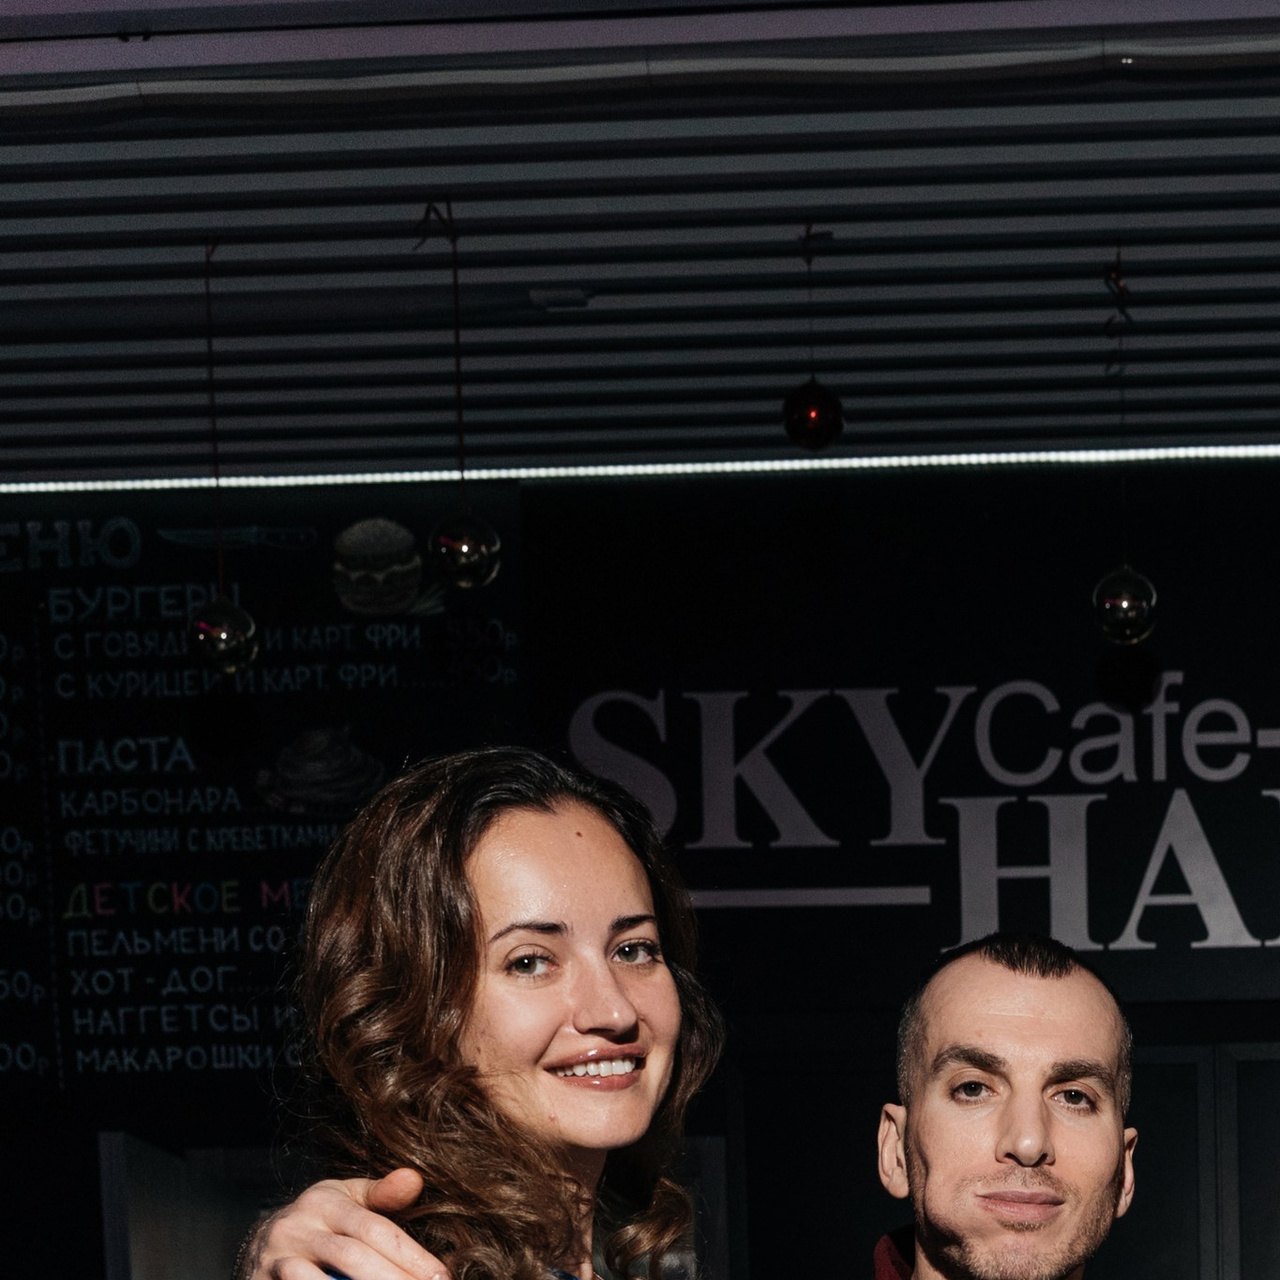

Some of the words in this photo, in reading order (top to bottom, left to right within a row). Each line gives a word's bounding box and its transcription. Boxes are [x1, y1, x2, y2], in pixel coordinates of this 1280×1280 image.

[53, 632, 76, 661] С
[84, 628, 190, 659] ГОВЯД
[291, 623, 356, 651] КАРТ
[364, 622, 422, 650] ФРИ
[54, 672, 77, 700] С
[336, 663, 400, 690] ФРИ
[57, 735, 198, 775] ПАСТА
[567, 684, 978, 851] SKY
[973, 669, 1253, 789] Cafe
[59, 785, 243, 818] КАРБОНАРА
[61, 878, 242, 920] ДЕТСКОЕ
[65, 926, 241, 957] ПЕЛЬМЕНИ
[247, 924, 285, 952] СО
[69, 966, 136, 997] ХОТ
[160, 964, 239, 997] ДОГ
[71, 1003, 260, 1036] НАГГЕТСЫ
[74, 1042, 278, 1074] МАКАРОШКИ
